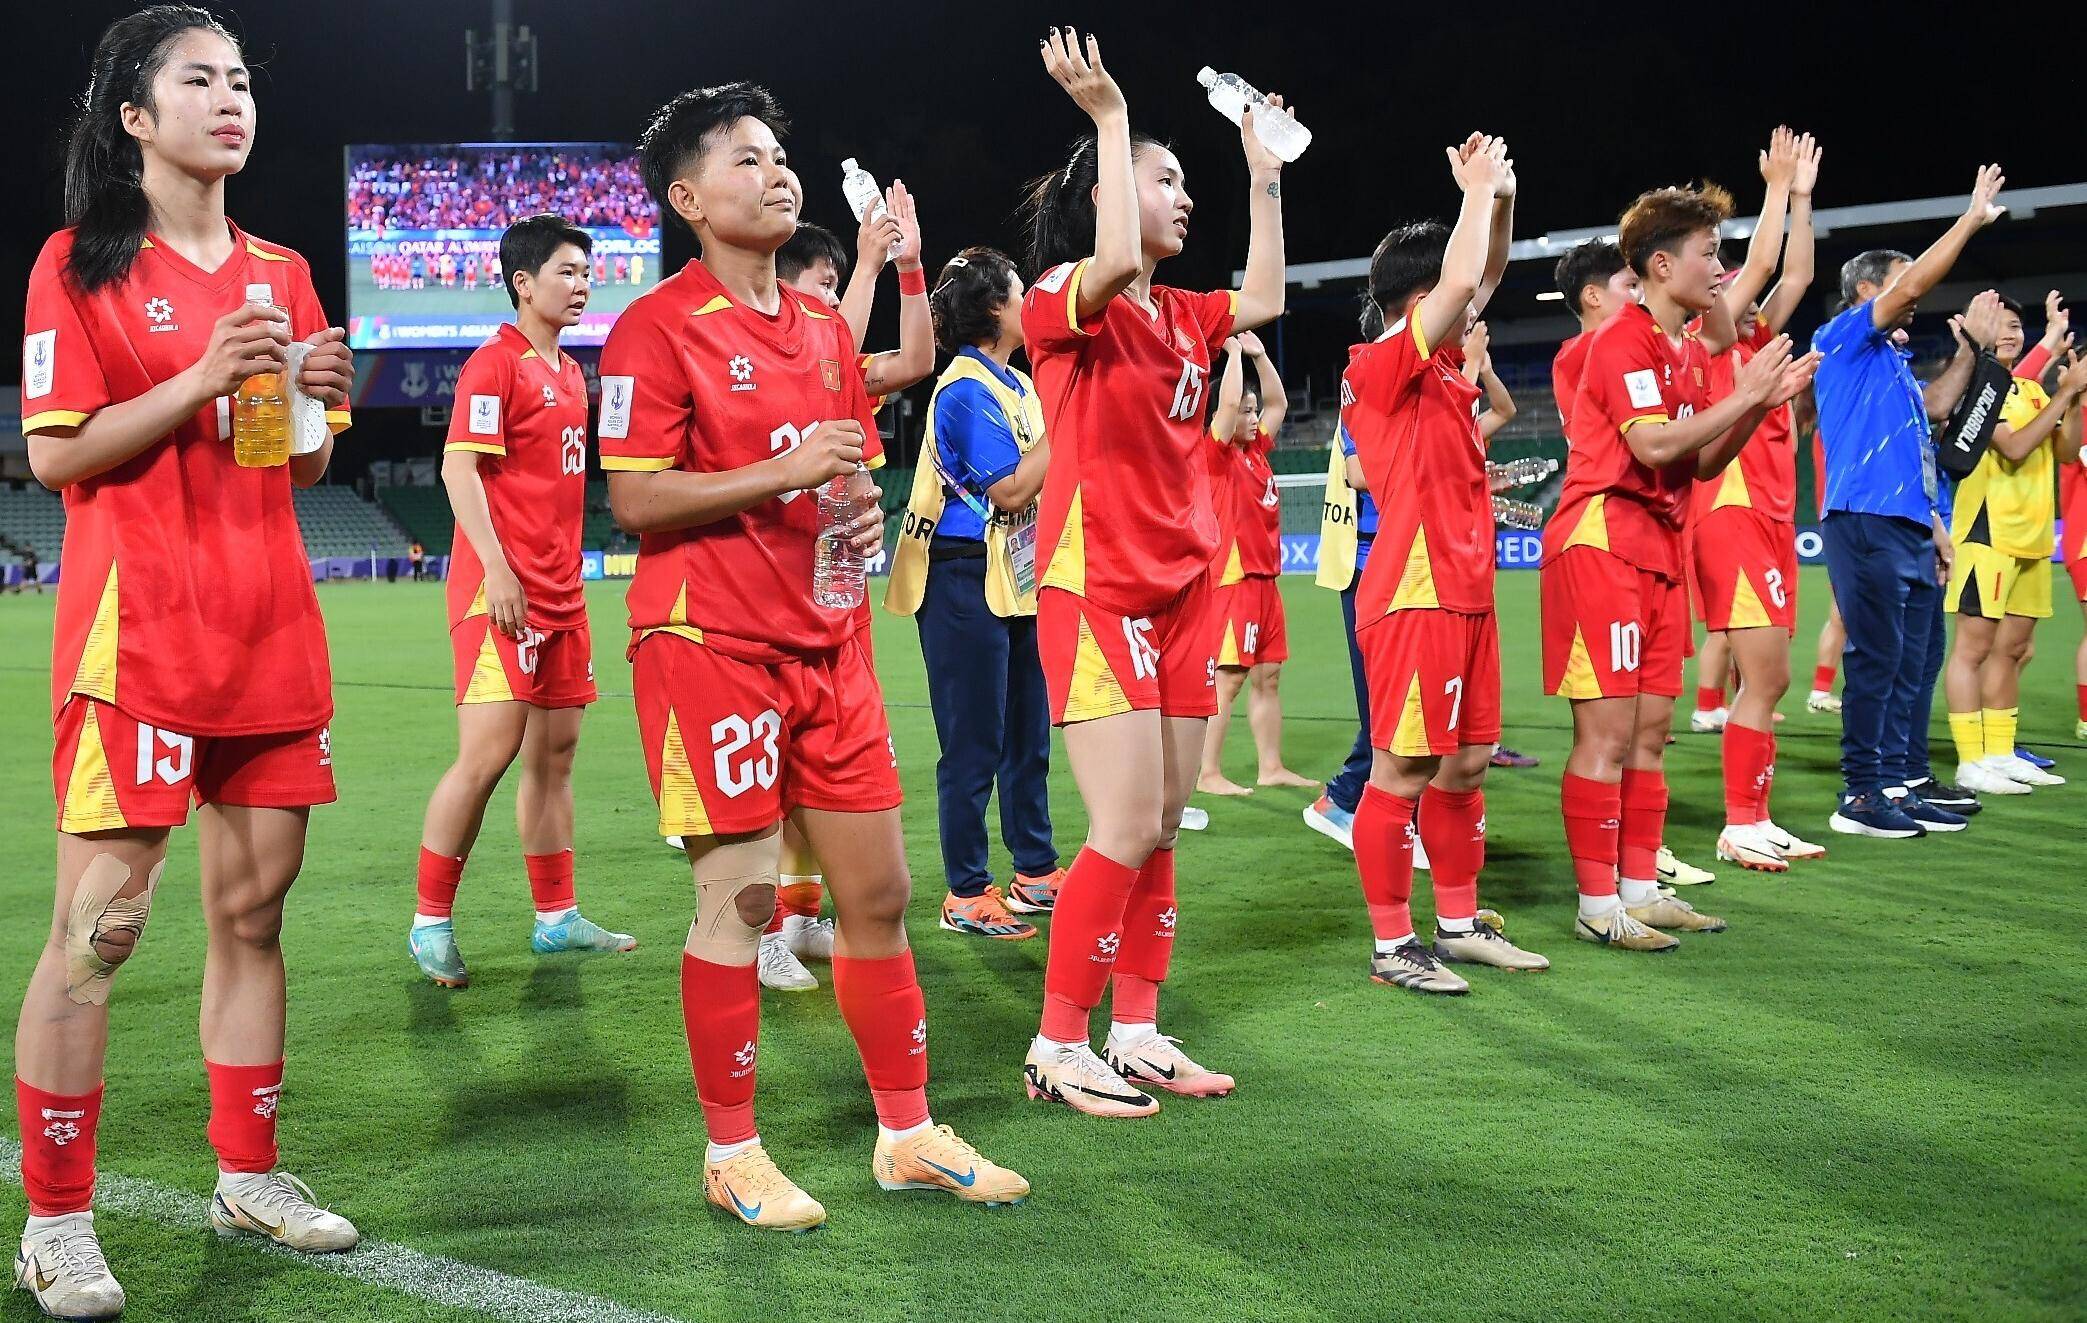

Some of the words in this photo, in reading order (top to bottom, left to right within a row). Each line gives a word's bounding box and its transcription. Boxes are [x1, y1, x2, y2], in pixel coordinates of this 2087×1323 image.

[1168, 359, 1206, 421] 15
[1764, 567, 1786, 608] 2
[1610, 621, 1641, 673] 10
[1444, 675, 1463, 732] 7
[711, 708, 782, 798] 23
